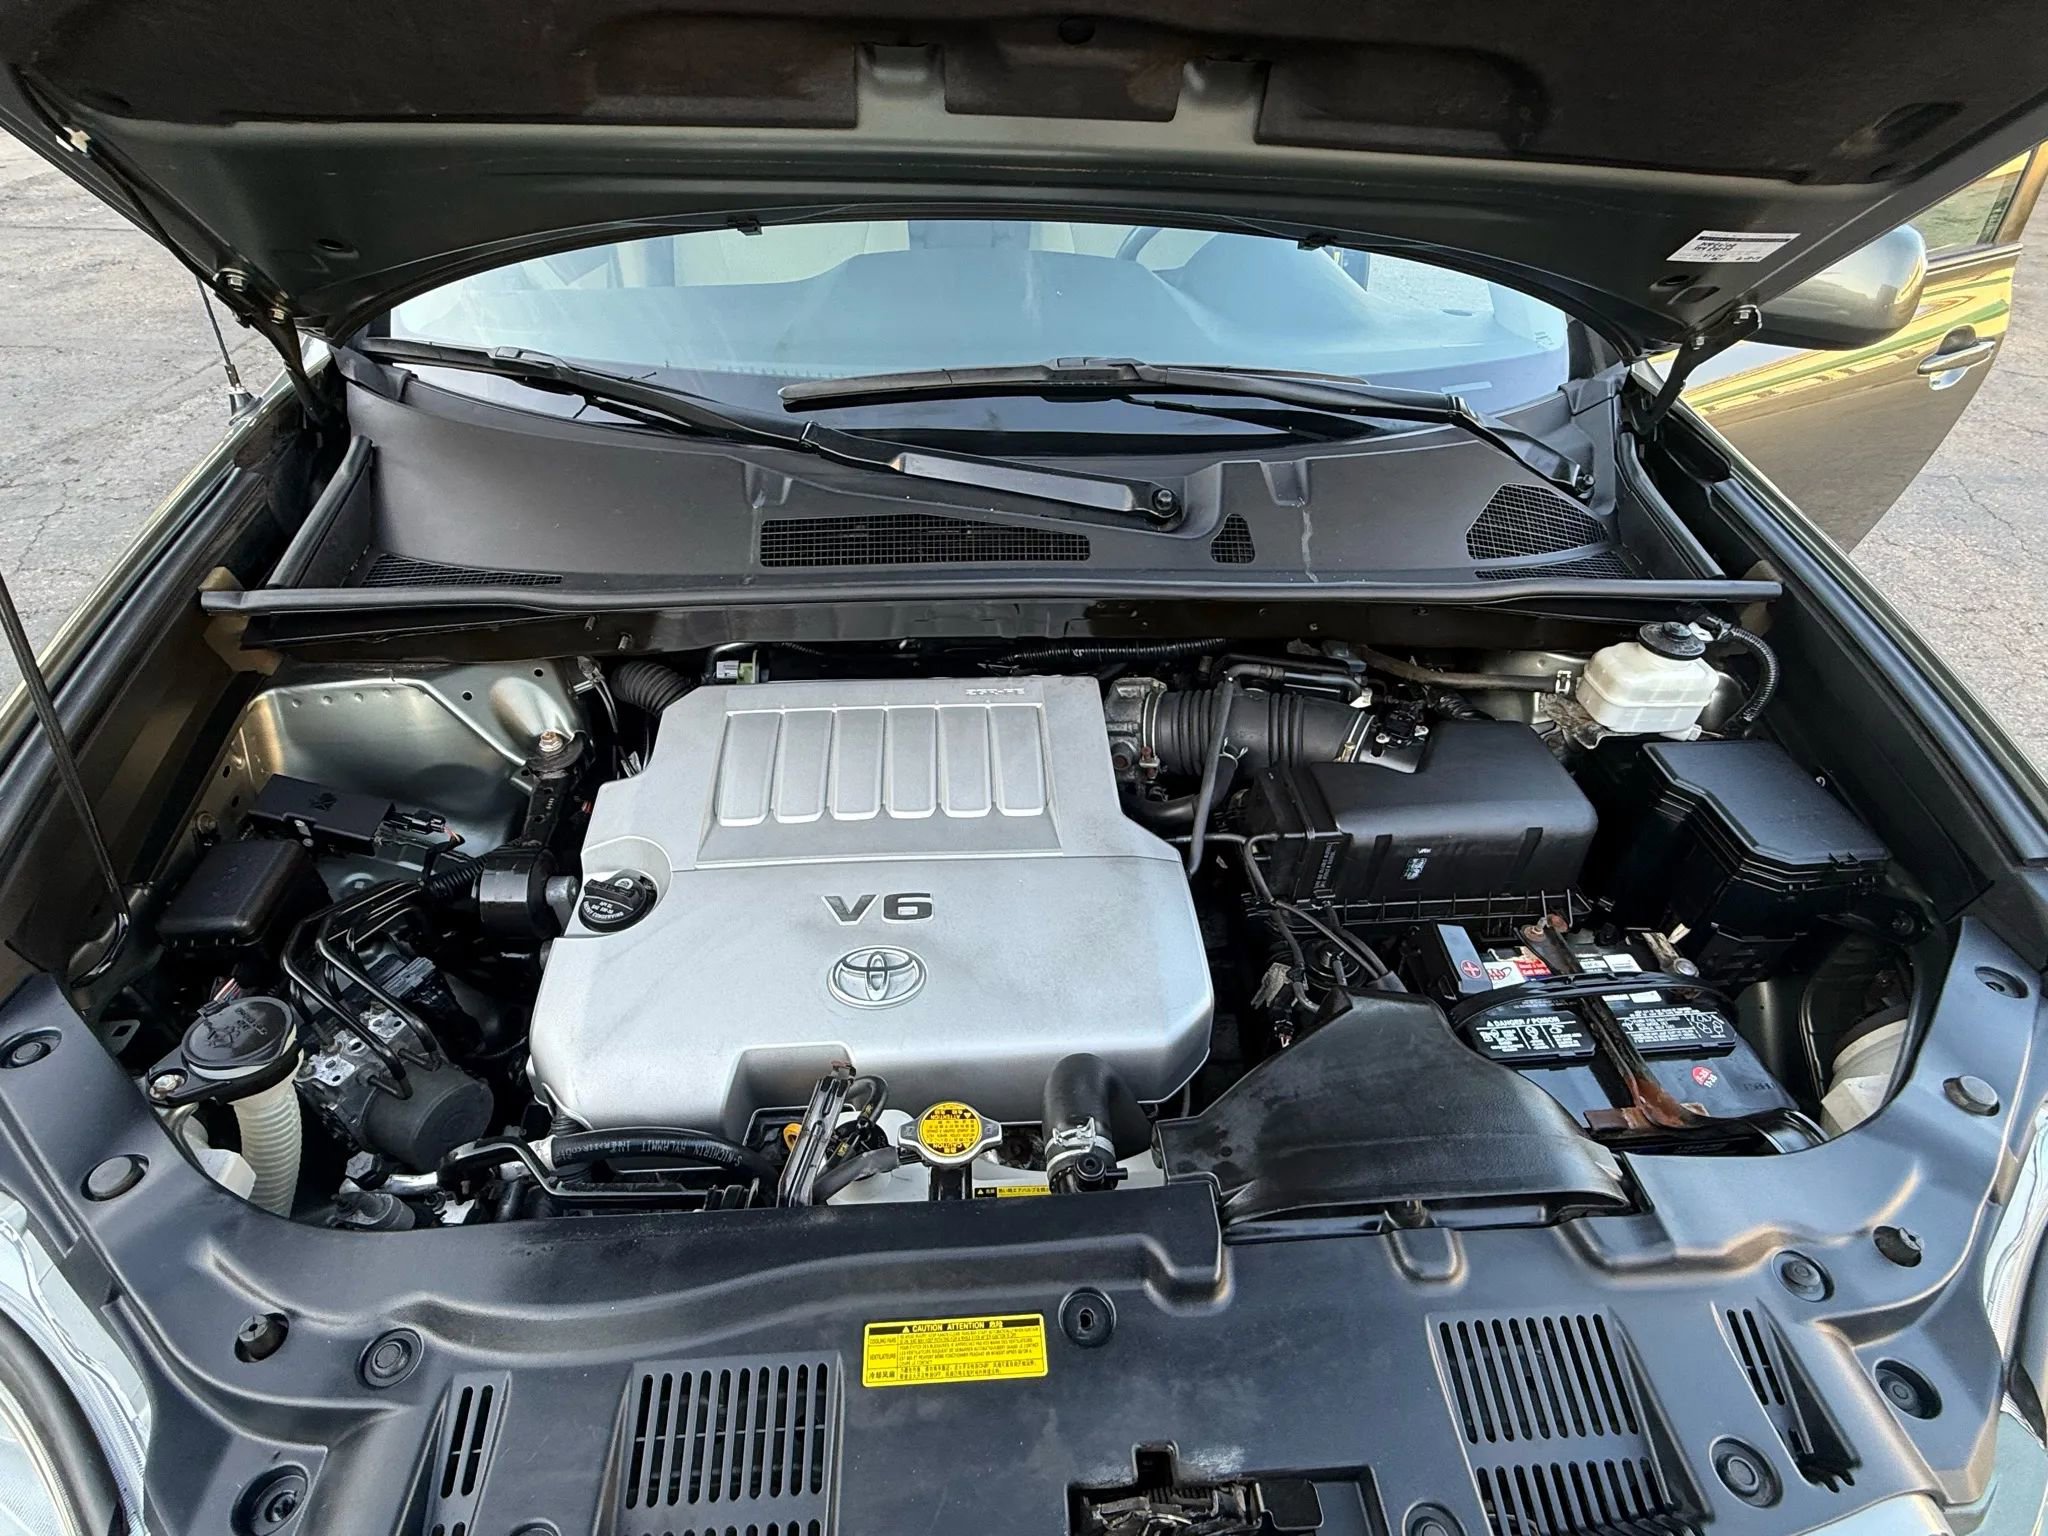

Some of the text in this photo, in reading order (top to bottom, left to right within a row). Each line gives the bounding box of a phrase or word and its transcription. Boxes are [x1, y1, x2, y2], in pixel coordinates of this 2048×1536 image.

[821, 891, 934, 925] V6
[1493, 1019, 1525, 1027] DANGER
[912, 1324, 942, 1332] CAUTION
[947, 1321, 984, 1331] ATTENTION
